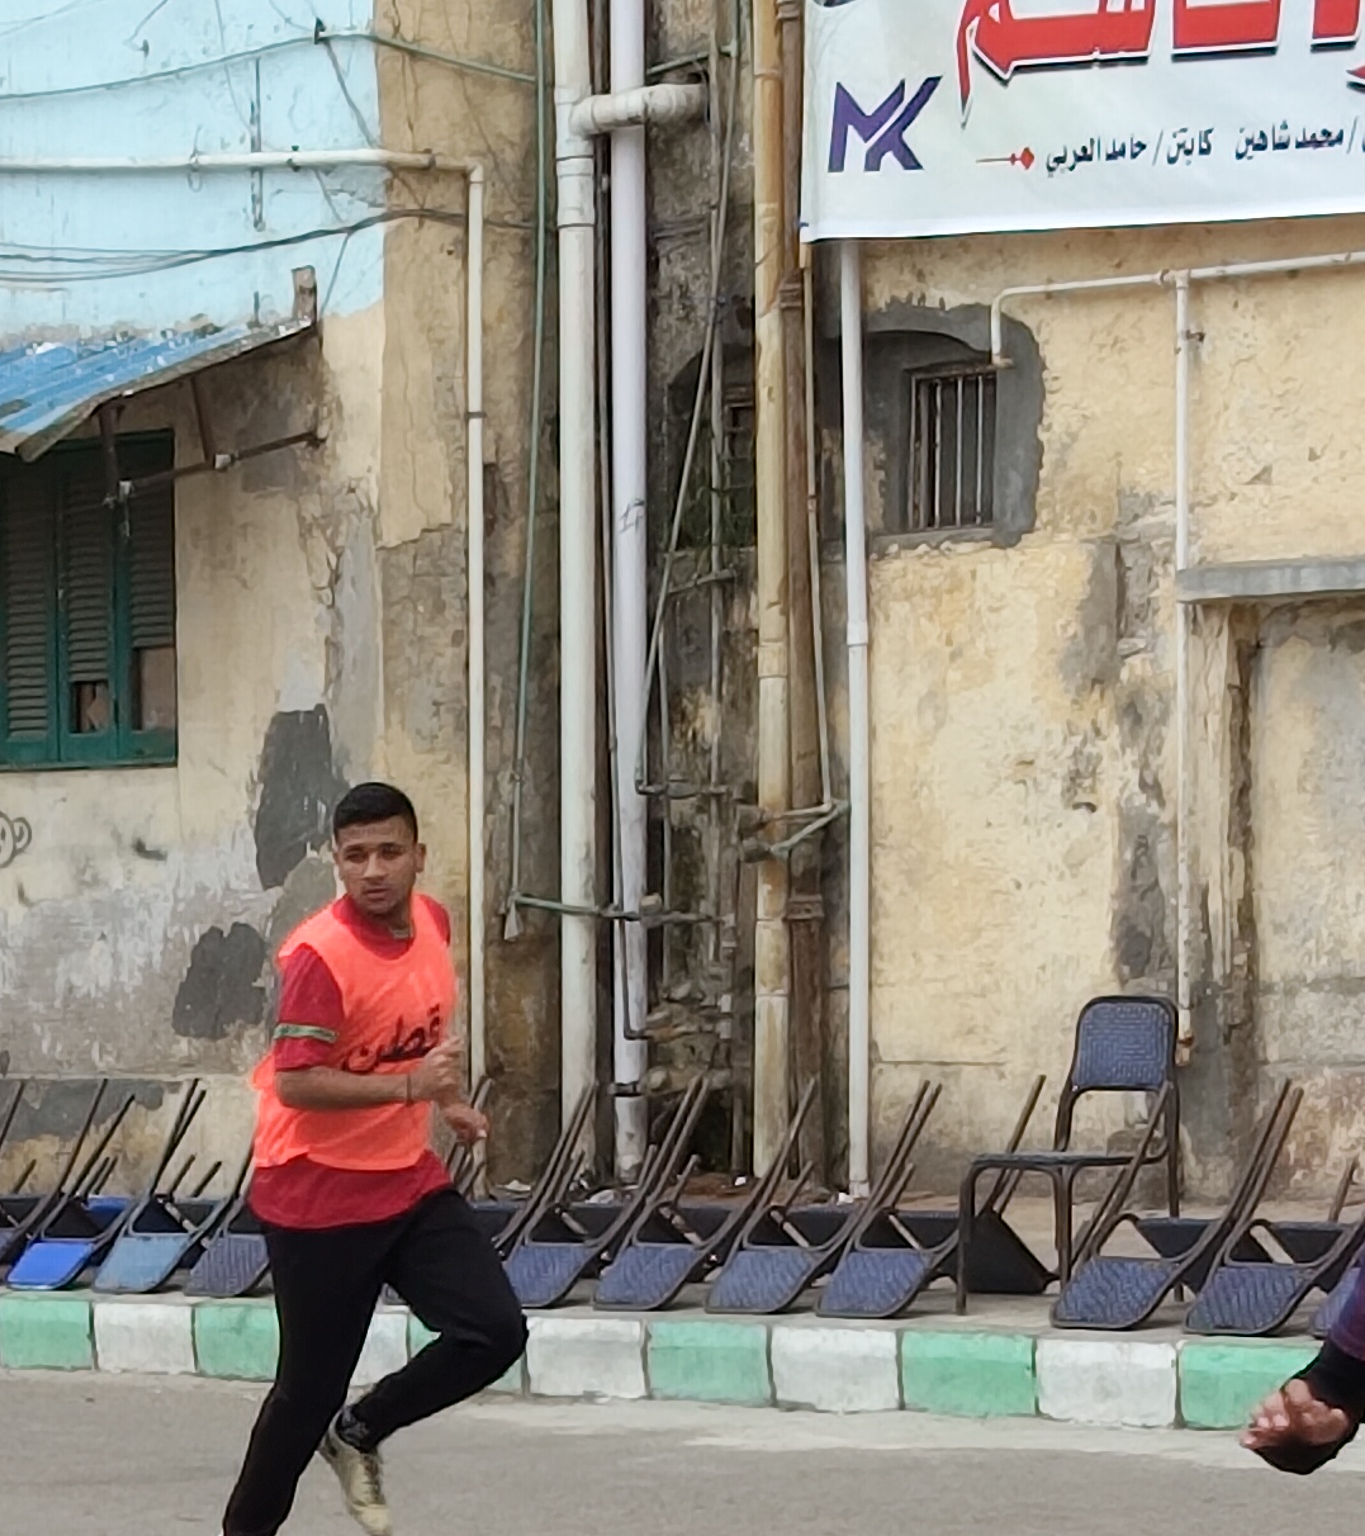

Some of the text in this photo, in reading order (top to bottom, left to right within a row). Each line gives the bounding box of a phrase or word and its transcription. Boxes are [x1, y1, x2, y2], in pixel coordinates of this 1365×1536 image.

[1104, 136, 1147, 161] حامد
[1234, 120, 1291, 161] شاهين
[1294, 127, 1345, 151] محمد
[1046, 136, 1101, 177] العربي
